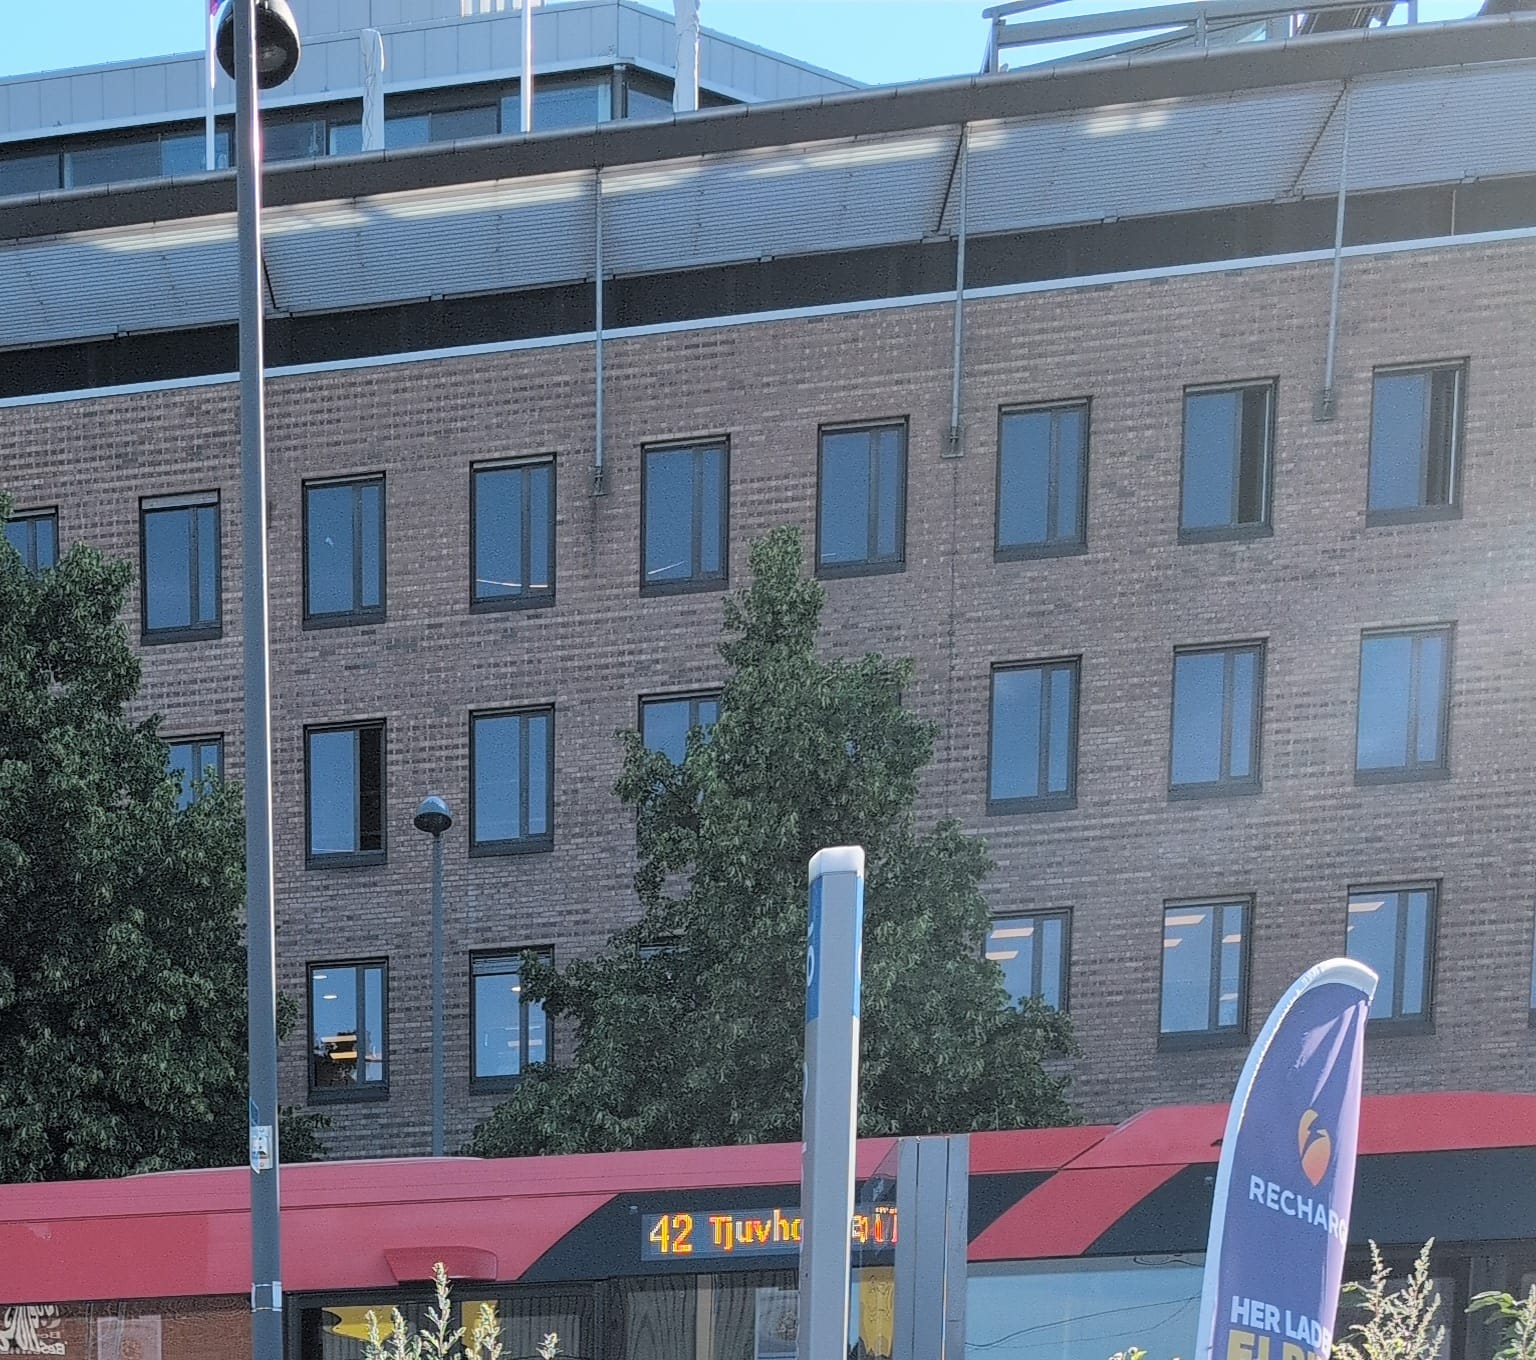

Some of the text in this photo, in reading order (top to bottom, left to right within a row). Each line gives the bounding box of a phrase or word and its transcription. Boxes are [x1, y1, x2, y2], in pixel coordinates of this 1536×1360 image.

[1249, 1175, 1349, 1246] RECHARG
[649, 1213, 694, 1254] 42
[1230, 1295, 1281, 1334] HER
